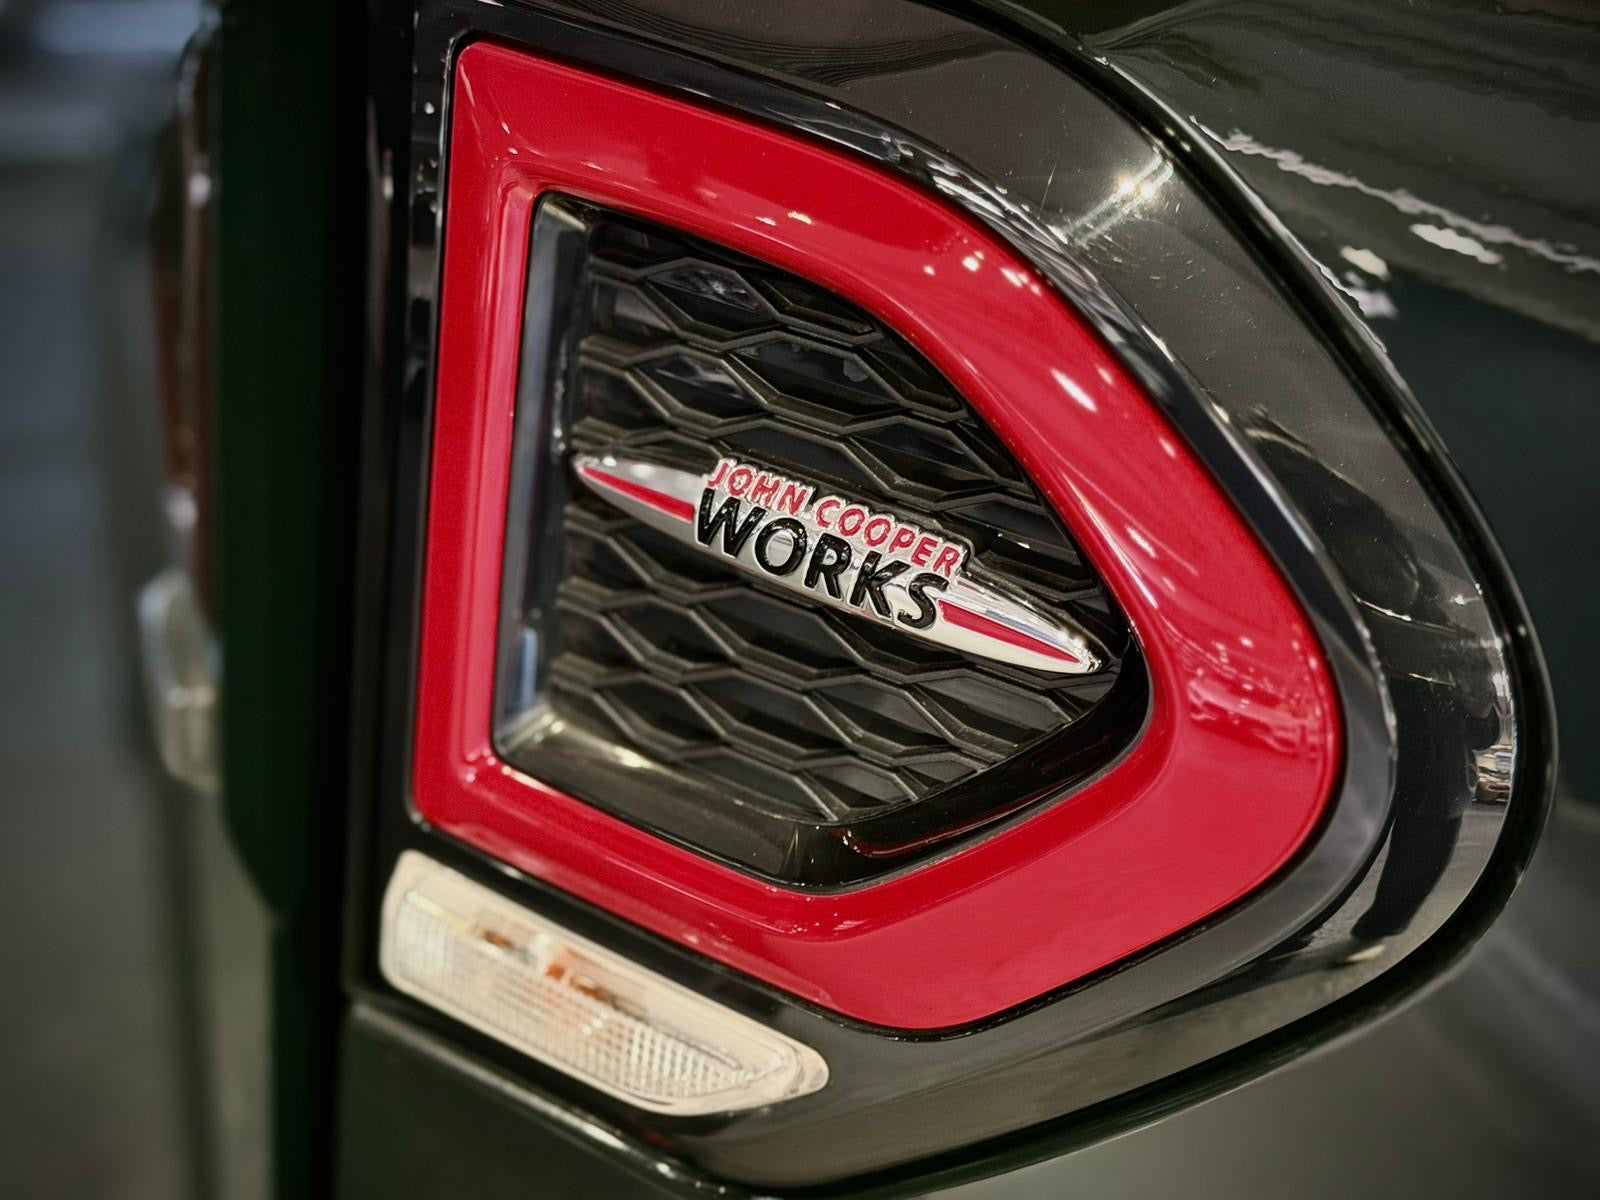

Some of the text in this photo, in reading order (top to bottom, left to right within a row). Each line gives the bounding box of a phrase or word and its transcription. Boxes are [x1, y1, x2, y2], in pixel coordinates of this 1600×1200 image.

[697, 488, 949, 629] WORKS
[708, 461, 961, 577] JOHN COOPER
